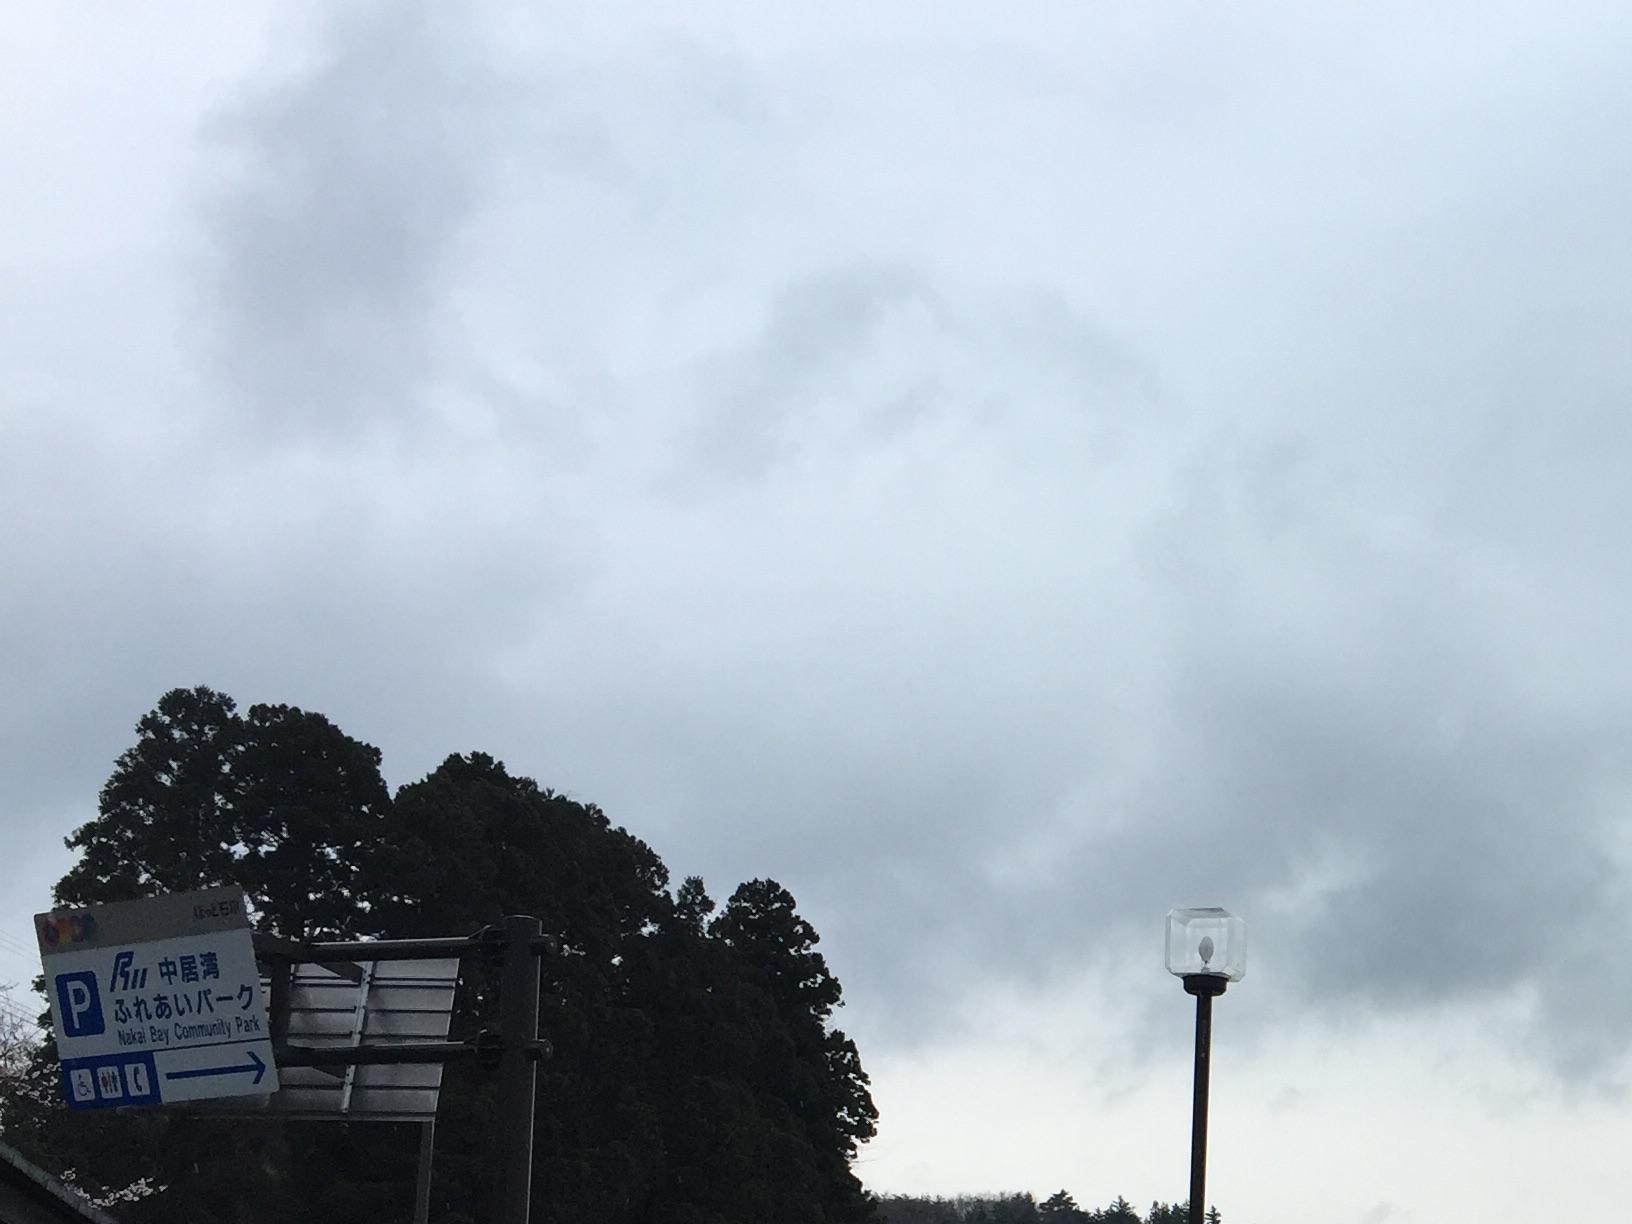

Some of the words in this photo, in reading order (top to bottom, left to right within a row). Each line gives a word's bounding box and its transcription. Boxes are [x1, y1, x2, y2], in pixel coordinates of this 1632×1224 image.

[159, 952, 219, 985] 中居湾
[67, 981, 90, 1029] P
[115, 985, 253, 1023] ふれあいパーク
[118, 1026, 146, 1045] Nakai
[151, 1026, 169, 1044] Bay
[175, 1020, 232, 1040] Community
[236, 1016, 261, 1032] Park
